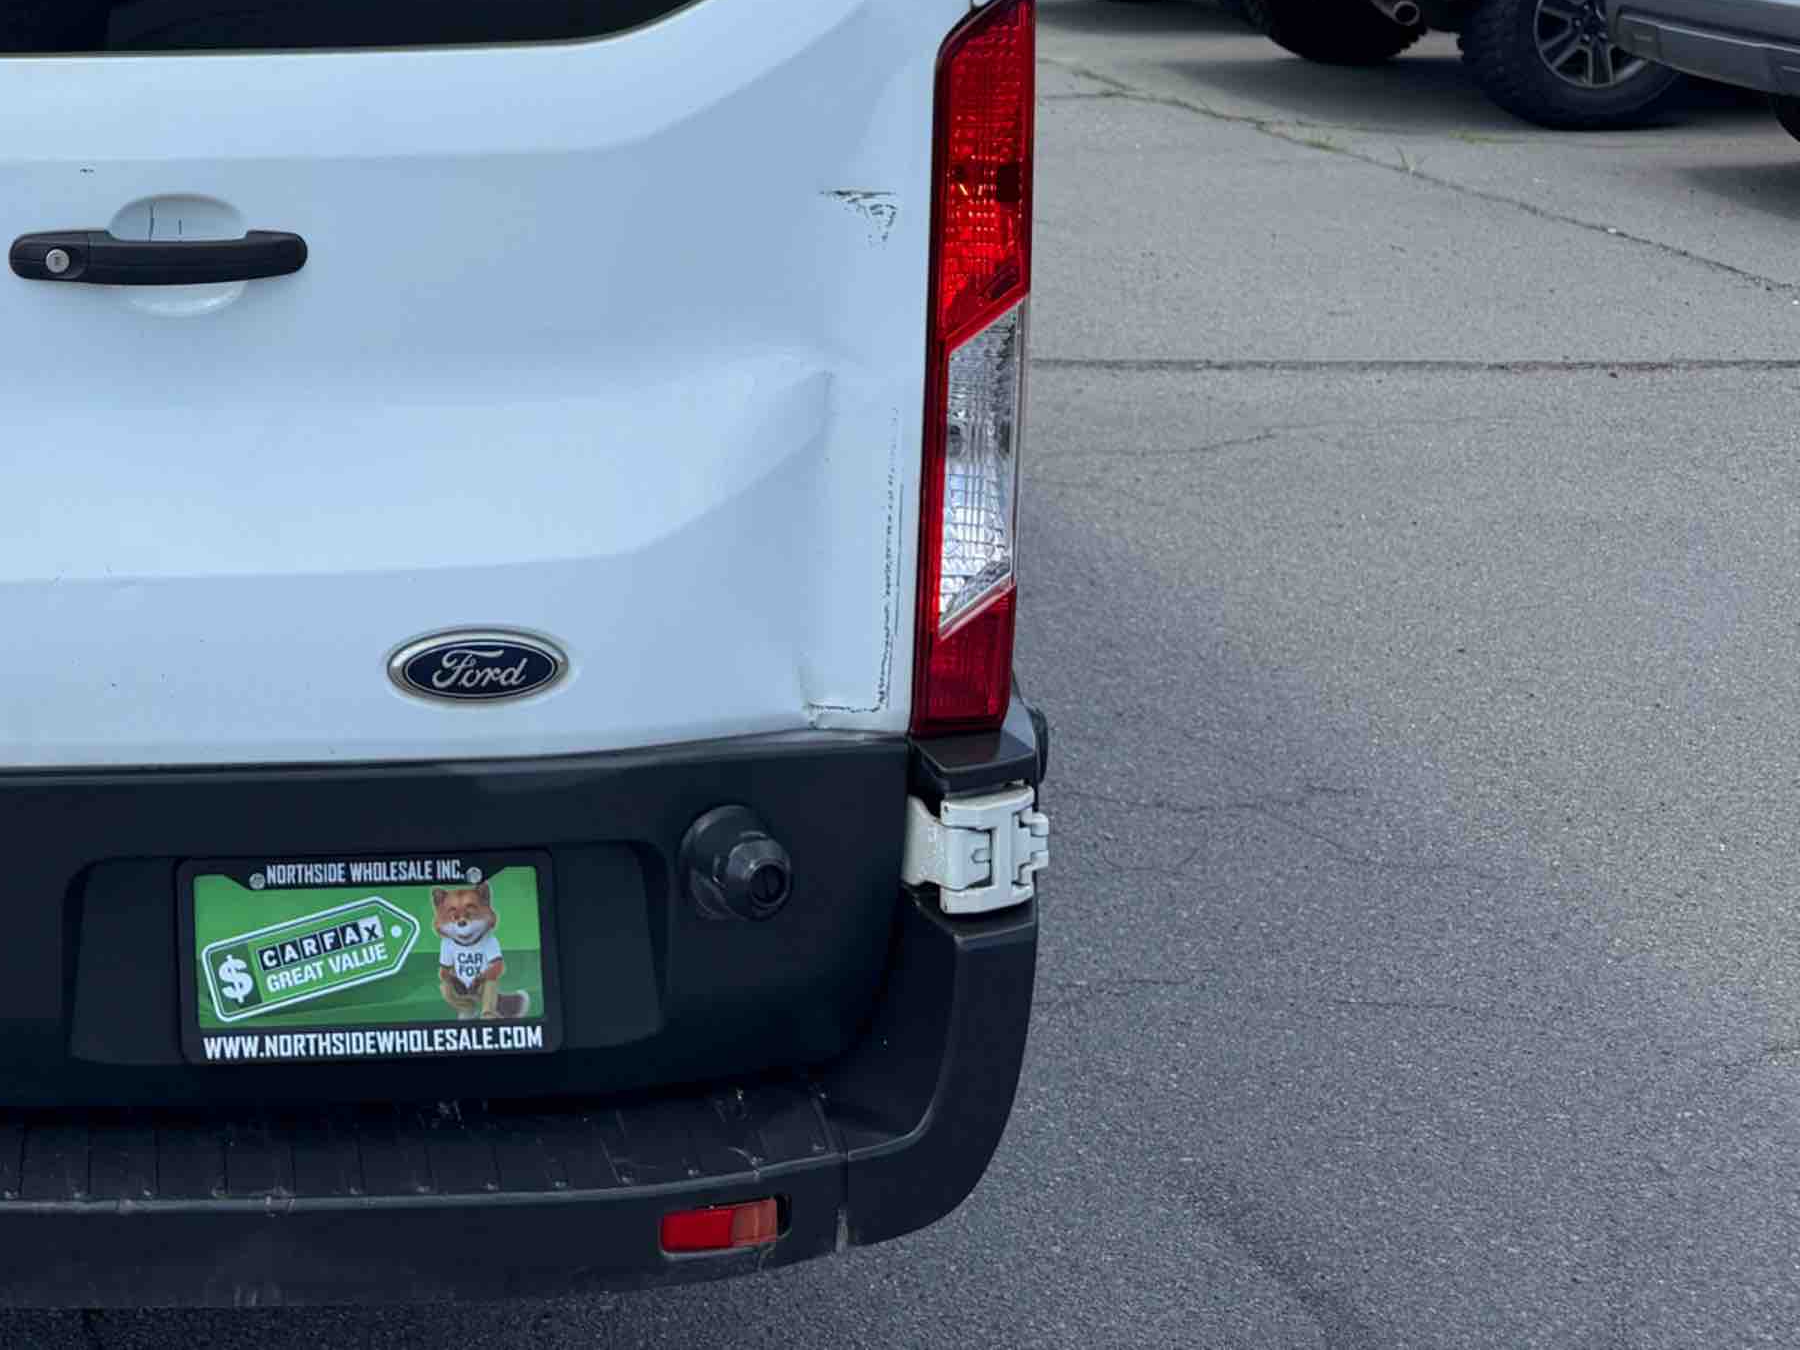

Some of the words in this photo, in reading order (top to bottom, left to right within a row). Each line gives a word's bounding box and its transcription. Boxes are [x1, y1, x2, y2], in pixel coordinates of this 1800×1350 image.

[431, 648, 528, 688] Ford
[266, 863, 346, 885] NORTHSIDE
[350, 861, 433, 883] WHOLESALE
[436, 859, 465, 880] INC.
[261, 920, 380, 968] CARFAX
[457, 952, 483, 964] CAR
[266, 961, 325, 993] GREAT
[328, 943, 388, 974] VALUE
[204, 1025, 543, 1060] WWW.NORTHSIDEWHOLESALE.COM
